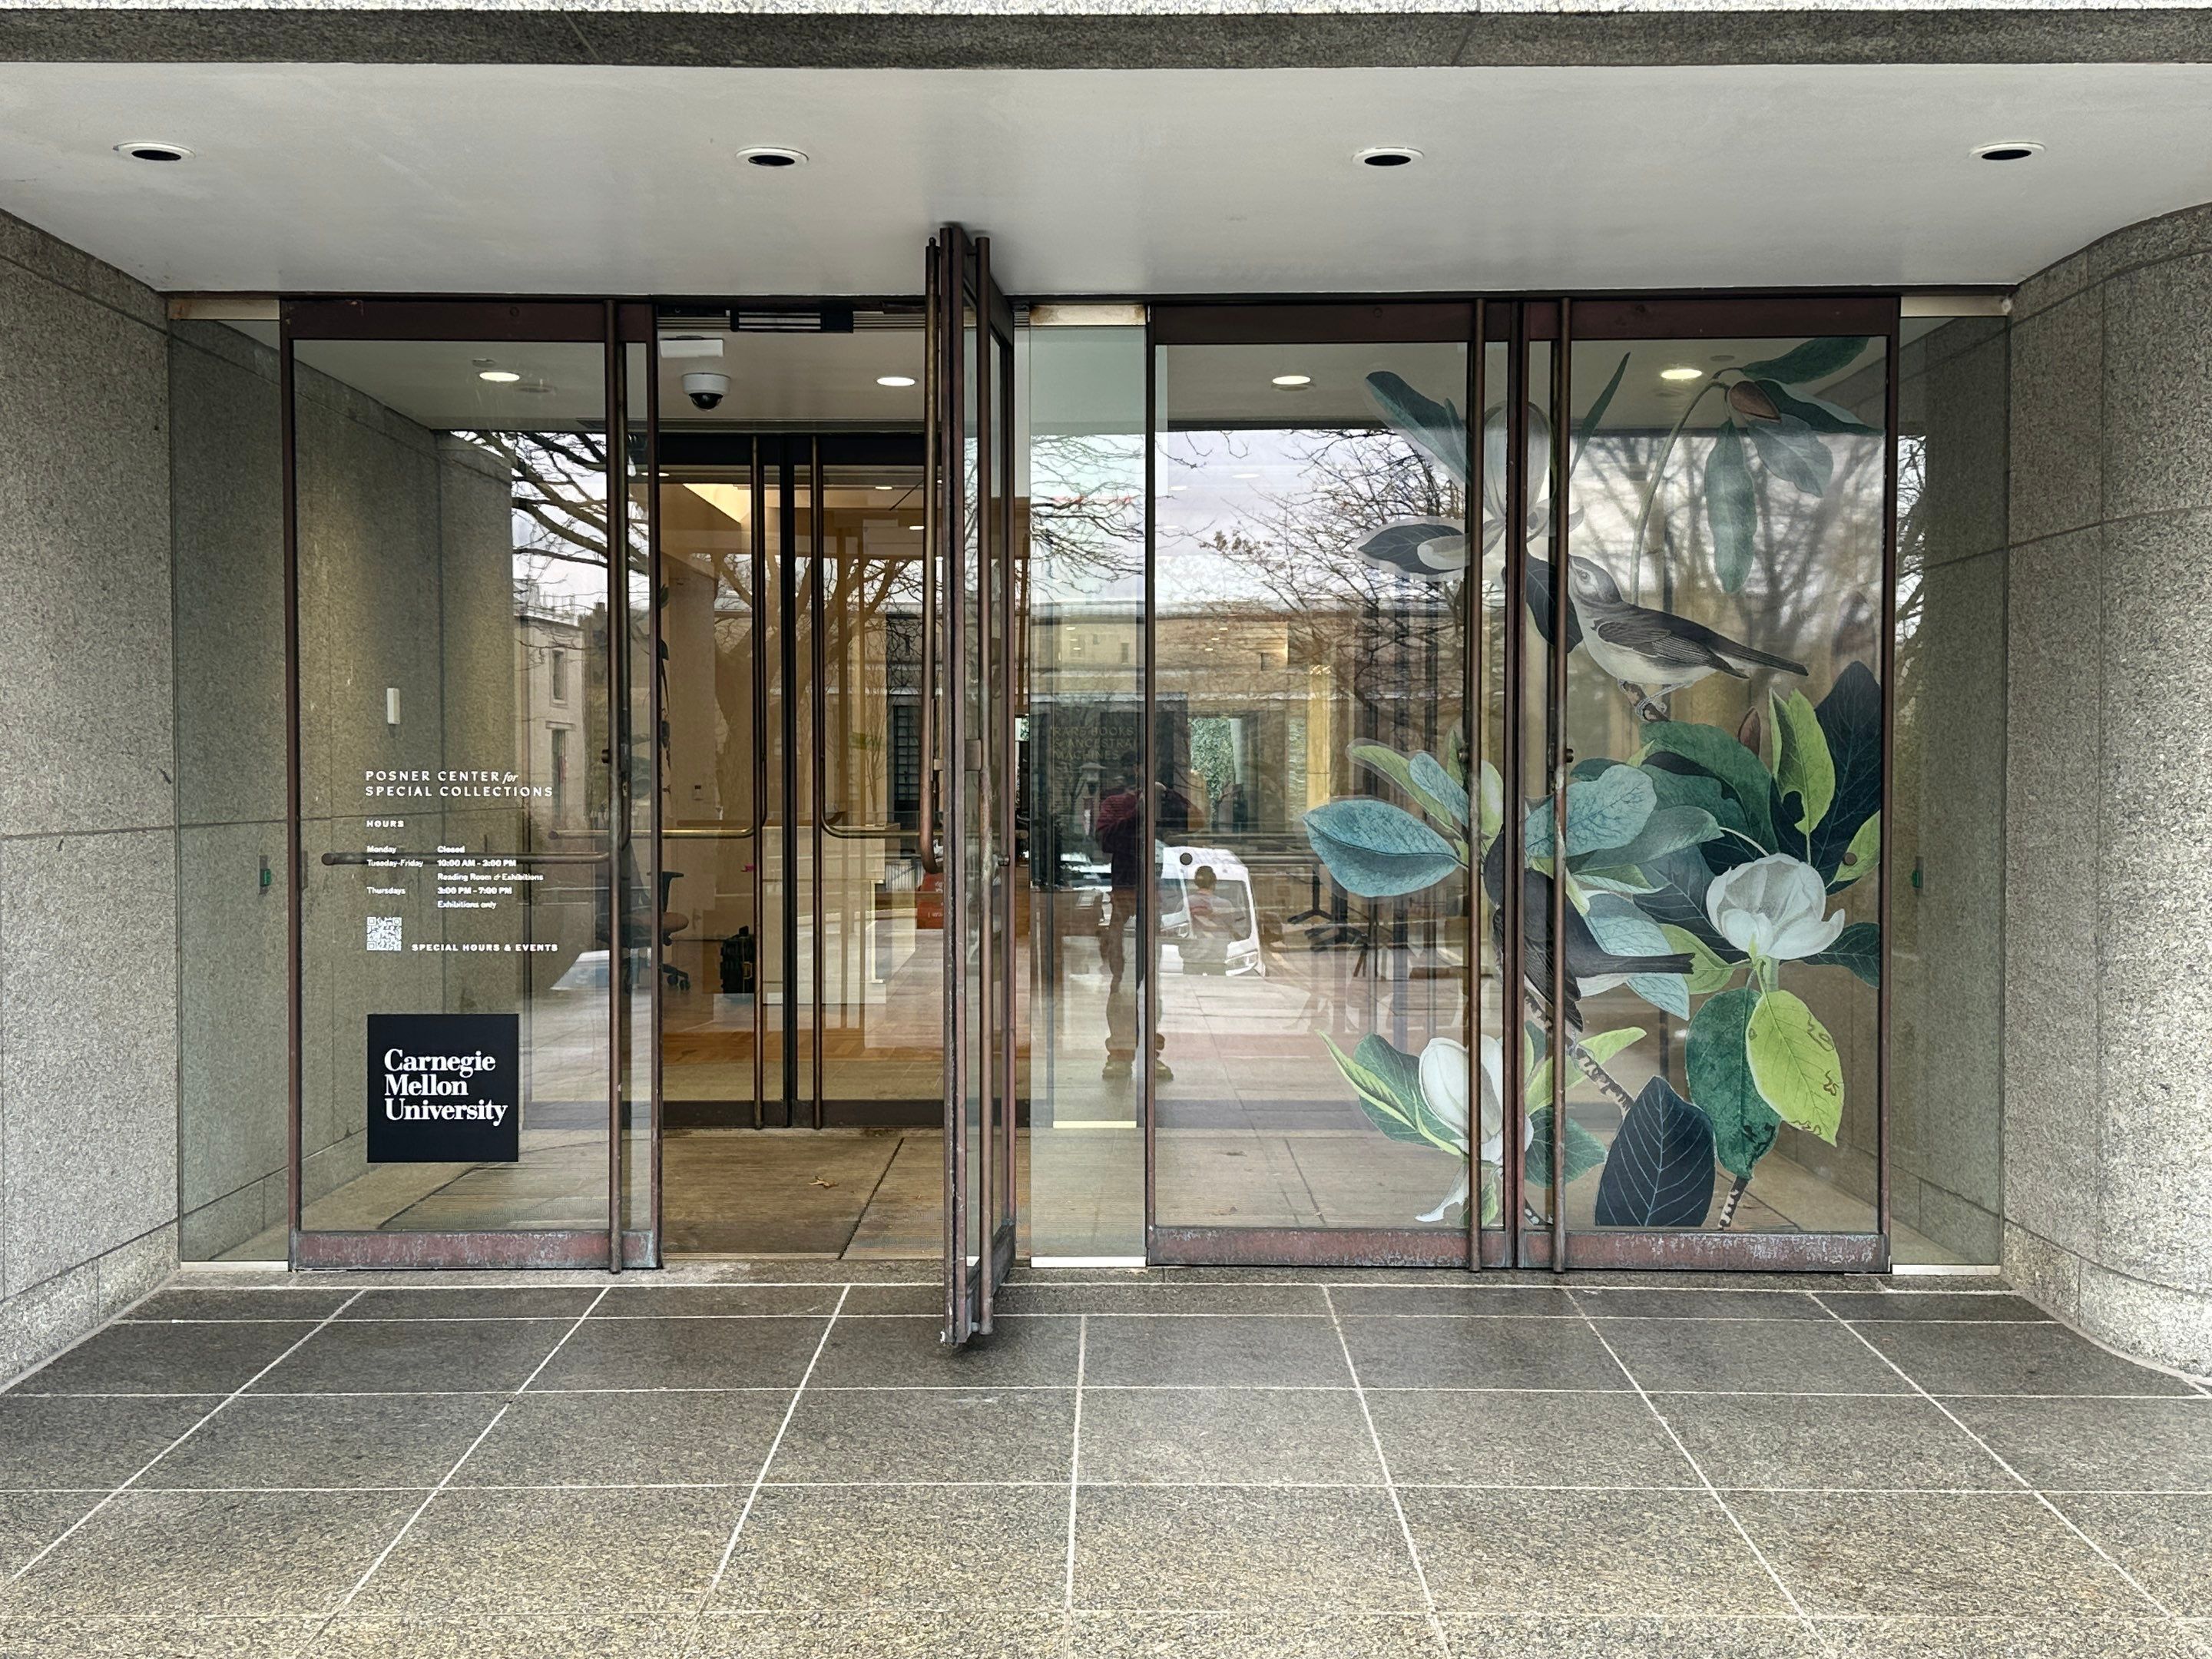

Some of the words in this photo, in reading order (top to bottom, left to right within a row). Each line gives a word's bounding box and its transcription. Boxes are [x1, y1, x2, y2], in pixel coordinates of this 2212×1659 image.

[1090, 726, 1134, 736] BOOKS
[1053, 750, 1119, 760] MACHINES
[366, 770, 430, 781] POSNER
[437, 770, 499, 782] CENTER
[502, 771, 519, 785] for
[365, 786, 432, 796] SPECIAL
[439, 786, 553, 797] COLLECTIONS
[366, 820, 404, 828] HOURS
[366, 845, 397, 854] Monday
[437, 845, 465, 853] Closed
[436, 859, 461, 867] 10:00
[462, 859, 475, 867] AM
[503, 859, 517, 867] PM
[437, 873, 469, 882] Reading
[469, 873, 492, 881] Room
[502, 873, 545, 881] Exhibitions
[366, 886, 406, 896] Thursdays
[458, 886, 472, 895] PM
[478, 886, 498, 895] 7:00
[498, 886, 512, 895] PM
[437, 900, 480, 909] Exhibitions
[480, 901, 497, 909] only
[411, 943, 459, 952] SPECIAL
[462, 943, 500, 952] HOURS
[504, 943, 512, 952] &
[515, 943, 559, 952] EVENTS
[384, 1048, 496, 1078] Carnegie
[384, 1073, 469, 1096] Mellon
[384, 1098, 508, 1127] University
